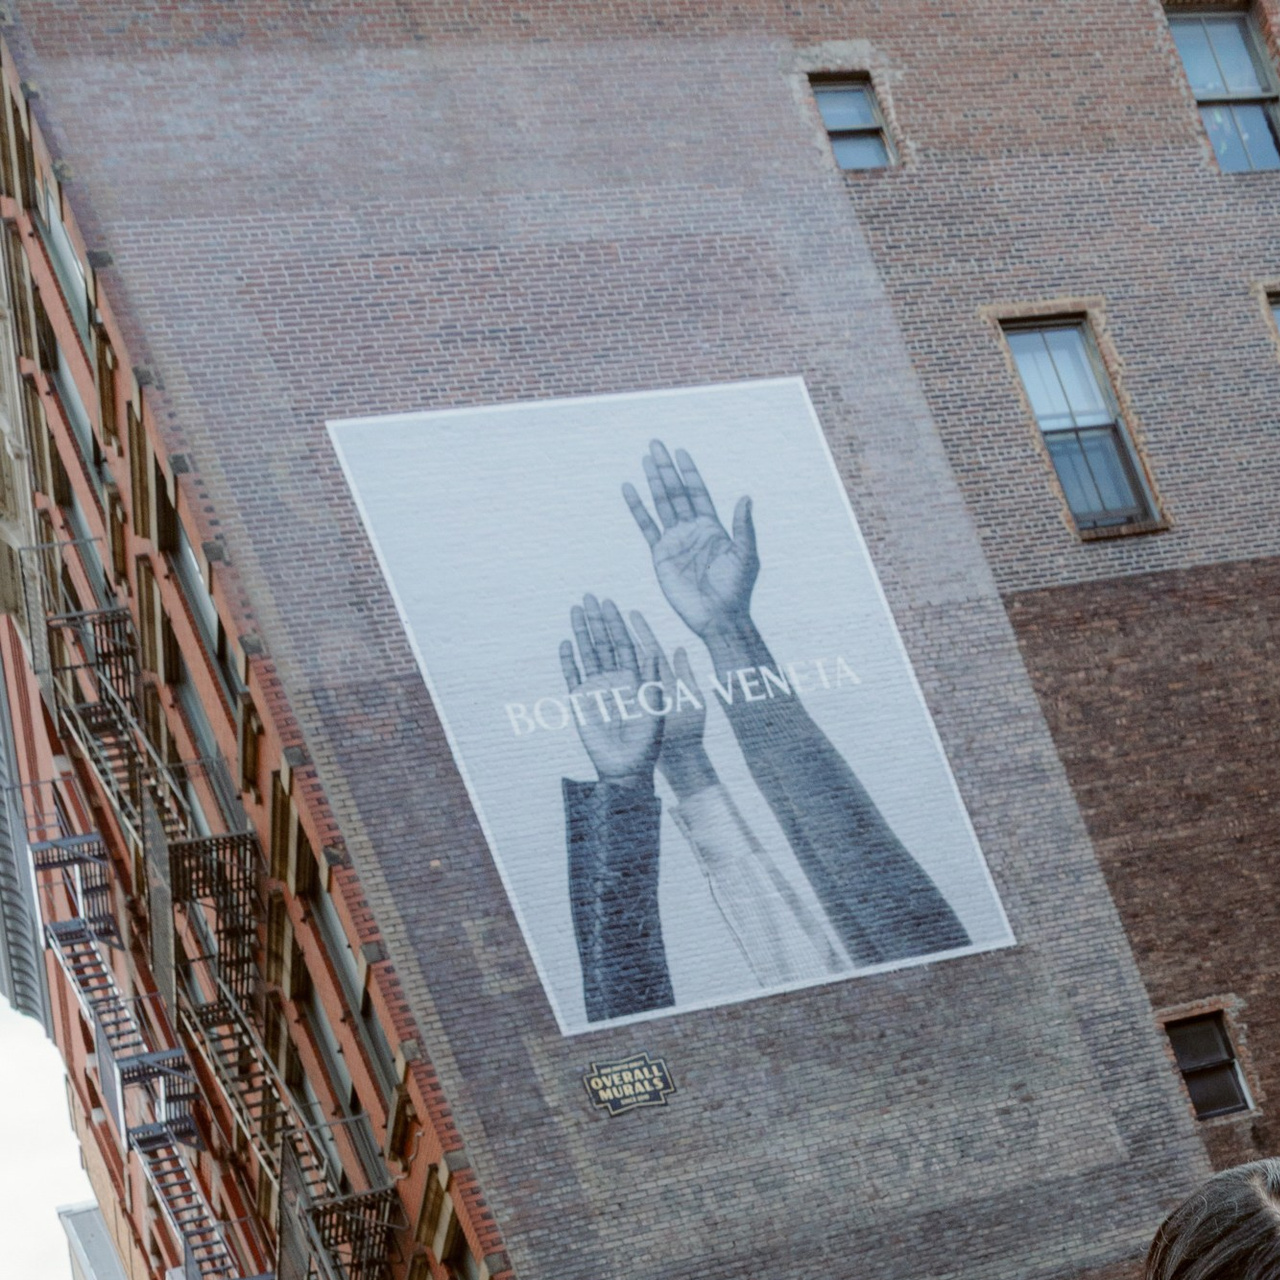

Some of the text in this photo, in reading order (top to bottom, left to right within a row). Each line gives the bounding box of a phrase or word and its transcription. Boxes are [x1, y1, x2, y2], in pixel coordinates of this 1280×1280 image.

[504, 655, 862, 737] BOTTEGA VENETA
[590, 1065, 663, 1090] OVERALL
[598, 1077, 664, 1101] MURALS
